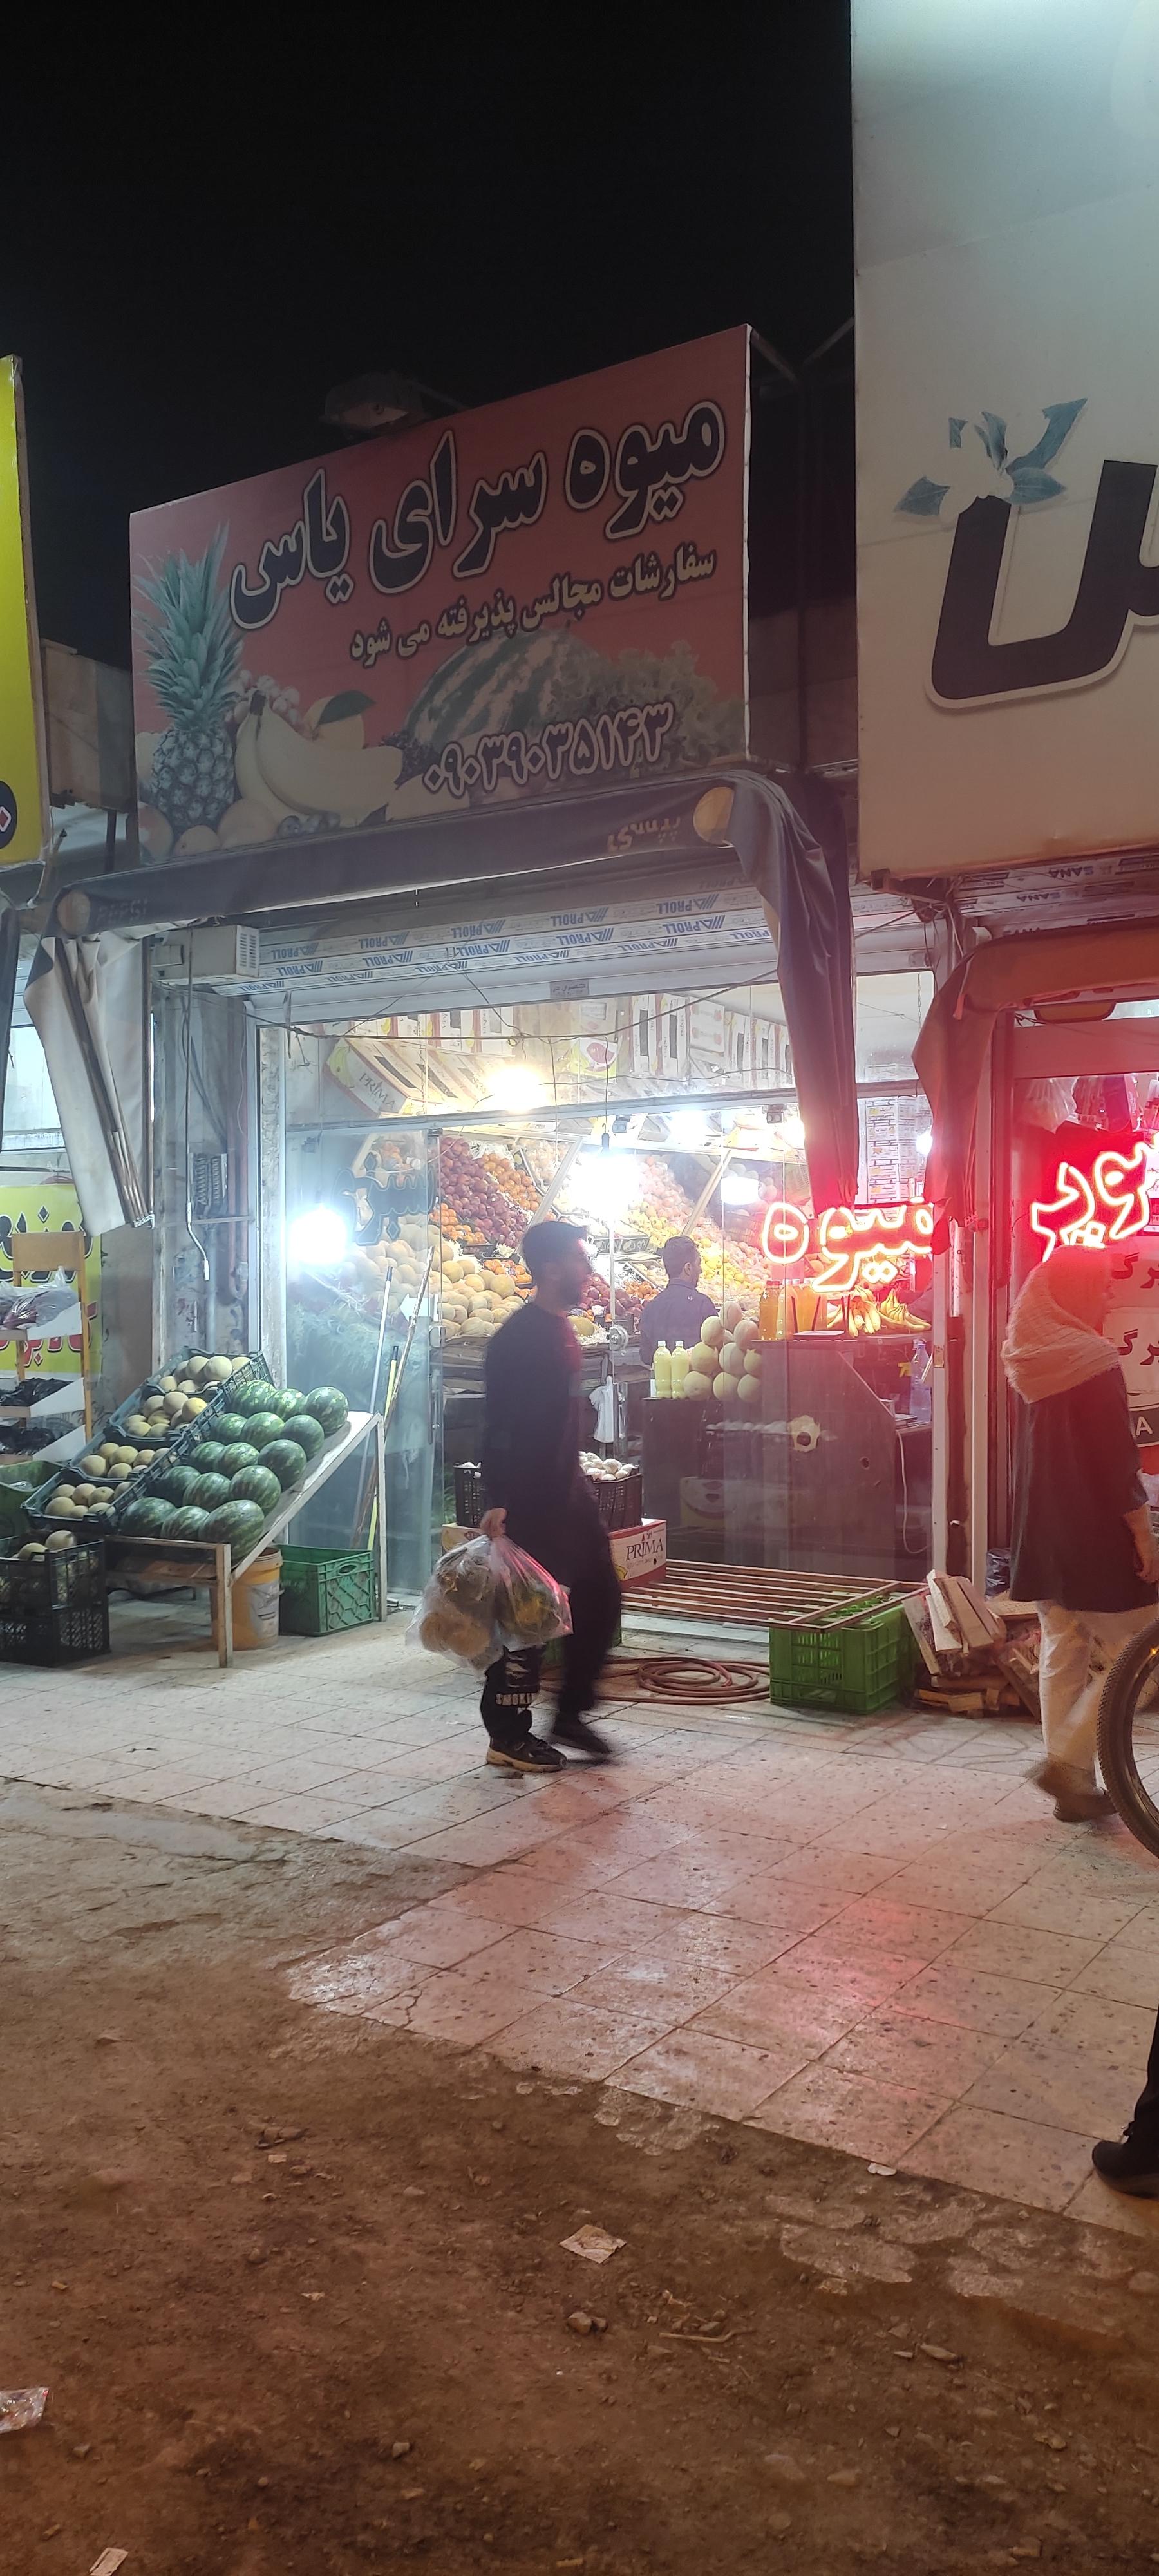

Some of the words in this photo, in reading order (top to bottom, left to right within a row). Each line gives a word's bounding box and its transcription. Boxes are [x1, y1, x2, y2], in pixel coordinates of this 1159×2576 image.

[565, 400, 726, 540] میوه
[369, 429, 548, 595] سرای
[229, 468, 356, 630] یاس
[612, 542, 716, 602] سفارشات
[437, 587, 515, 644] پذیرفته
[522, 573, 603, 631] مجالس
[351, 619, 391, 667] شود
[397, 622, 430, 658] می
[422, 701, 674, 797] ۰۹۰۳۹۰۳۵۱۴۳
[762, 1201, 933, 1293] میوه
[625, 1537, 663, 1561] PRIMA
